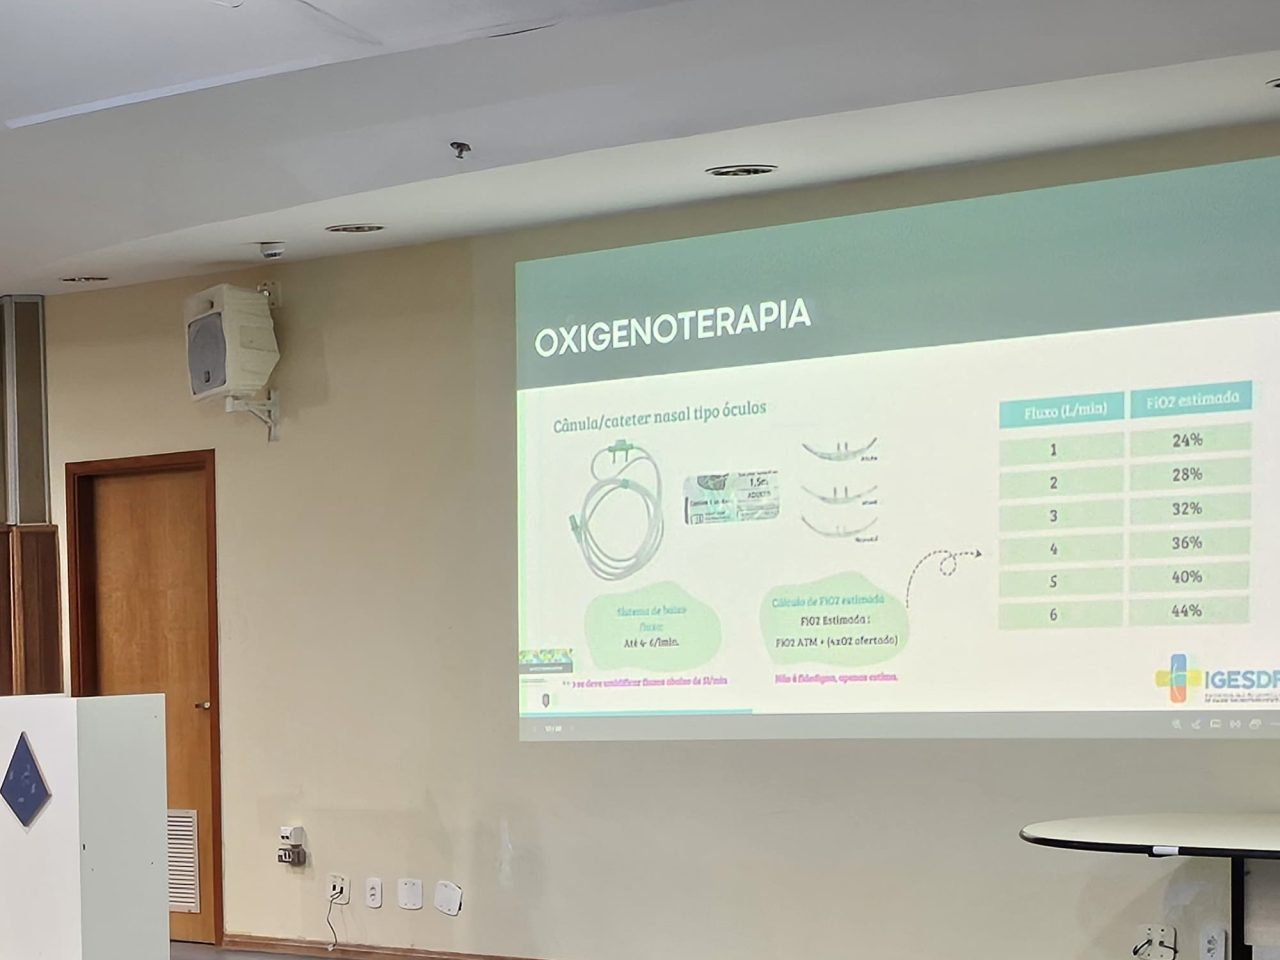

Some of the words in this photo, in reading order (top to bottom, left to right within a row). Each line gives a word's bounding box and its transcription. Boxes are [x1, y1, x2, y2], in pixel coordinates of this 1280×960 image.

[534, 297, 812, 358] OXIGENOTERAPIA
[553, 411, 651, 434] Cânula/cateter
[653, 406, 690, 425] nasal
[693, 405, 720, 423] tipo
[722, 400, 767, 417] óculos
[1024, 406, 1058, 420] Fluxo
[1171, 433, 1203, 448] 24%
[1051, 444, 1057, 457] 1
[1171, 467, 1203, 482] 28%
[1049, 476, 1058, 490] 2
[1171, 501, 1203, 516] 32%
[1049, 509, 1058, 523] 3
[1049, 543, 1058, 555] 4
[1171, 536, 1203, 550] 36%
[1049, 575, 1058, 588] 5
[1171, 570, 1203, 584] 40%
[1049, 608, 1058, 621] 6
[1171, 604, 1203, 618] 44%
[797, 637, 818, 647] ATM
[1205, 670, 1280, 690] IGESDF
